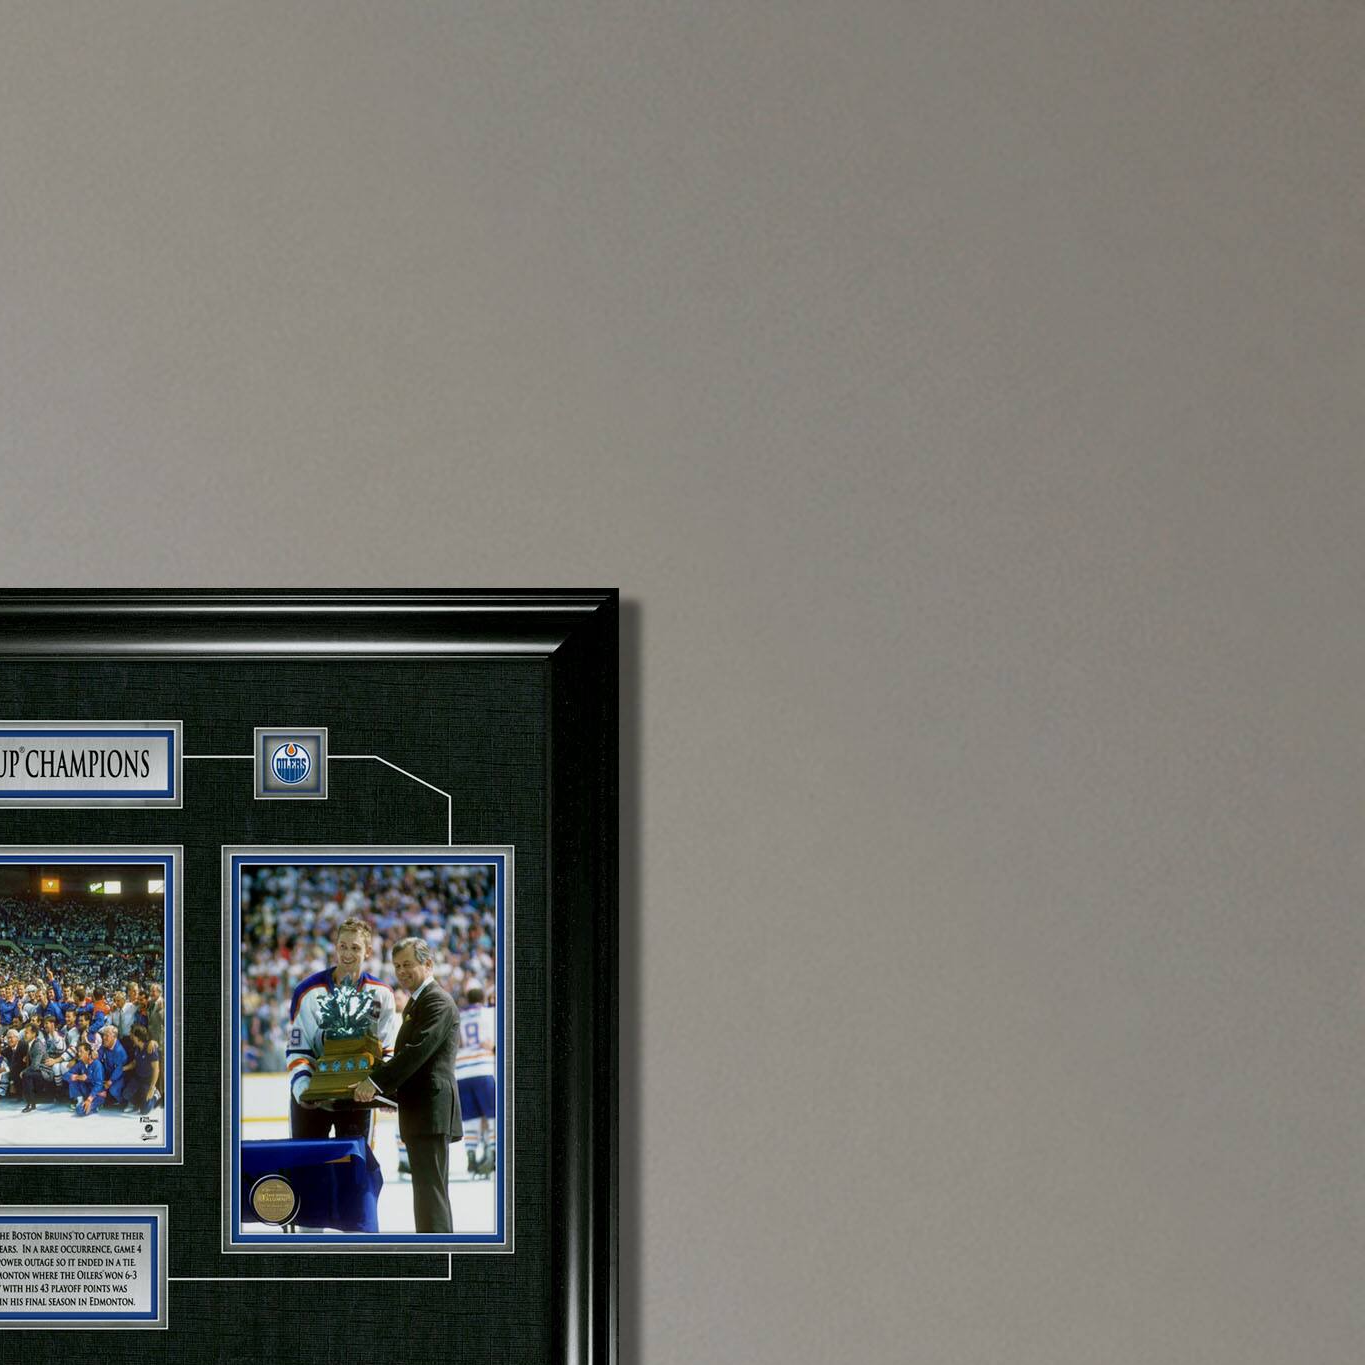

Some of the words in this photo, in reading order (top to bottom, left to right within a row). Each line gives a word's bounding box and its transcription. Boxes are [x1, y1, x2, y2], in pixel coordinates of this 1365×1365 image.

[25, 749, 150, 778] CHAMPIONS
[12, 1231, 42, 1240] BOSTON
[74, 1231, 85, 1240] TO
[87, 1231, 119, 1240] CAPTURE
[121, 1231, 145, 1240] THEIR
[23, 1244, 31, 1254] IN
[33, 1244, 39, 1254] A
[41, 1244, 58, 1254] RARE
[61, 1244, 113, 1254] OCCURRENCE,
[114, 1244, 135, 1254] GAME
[137, 1244, 141, 1254] 4
[25, 1258, 54, 1266] OUTAGE
[56, 1258, 66, 1266] SO
[68, 1258, 75, 1266] IT
[77, 1258, 103, 1266] ENDED
[105, 1258, 114, 1266] IN
[115, 1258, 121, 1266] A
[123, 1258, 136, 1266] TIE.
[32, 1271, 58, 1280] WHERE
[60, 1271, 75, 1280] THE
[105, 1271, 123, 1280] WON
[125, 1271, 137, 1280] 6-3
[3, 1284, 23, 1292] WITH
[25, 1284, 39, 1292] HIS
[40, 1284, 49, 1292] 43
[51, 1284, 81, 1292] PLAYOFF
[83, 1284, 111, 1292] POINTS
[112, 1284, 127, 1292] WAS
[0, 1297, 7, 1306] IN
[10, 1297, 23, 1306] HIS
[25, 1297, 47, 1306] FINAL
[49, 1297, 76, 1306] SEASON
[79, 1297, 87, 1306] IN
[89, 1297, 135, 1306] EDMONTON.
